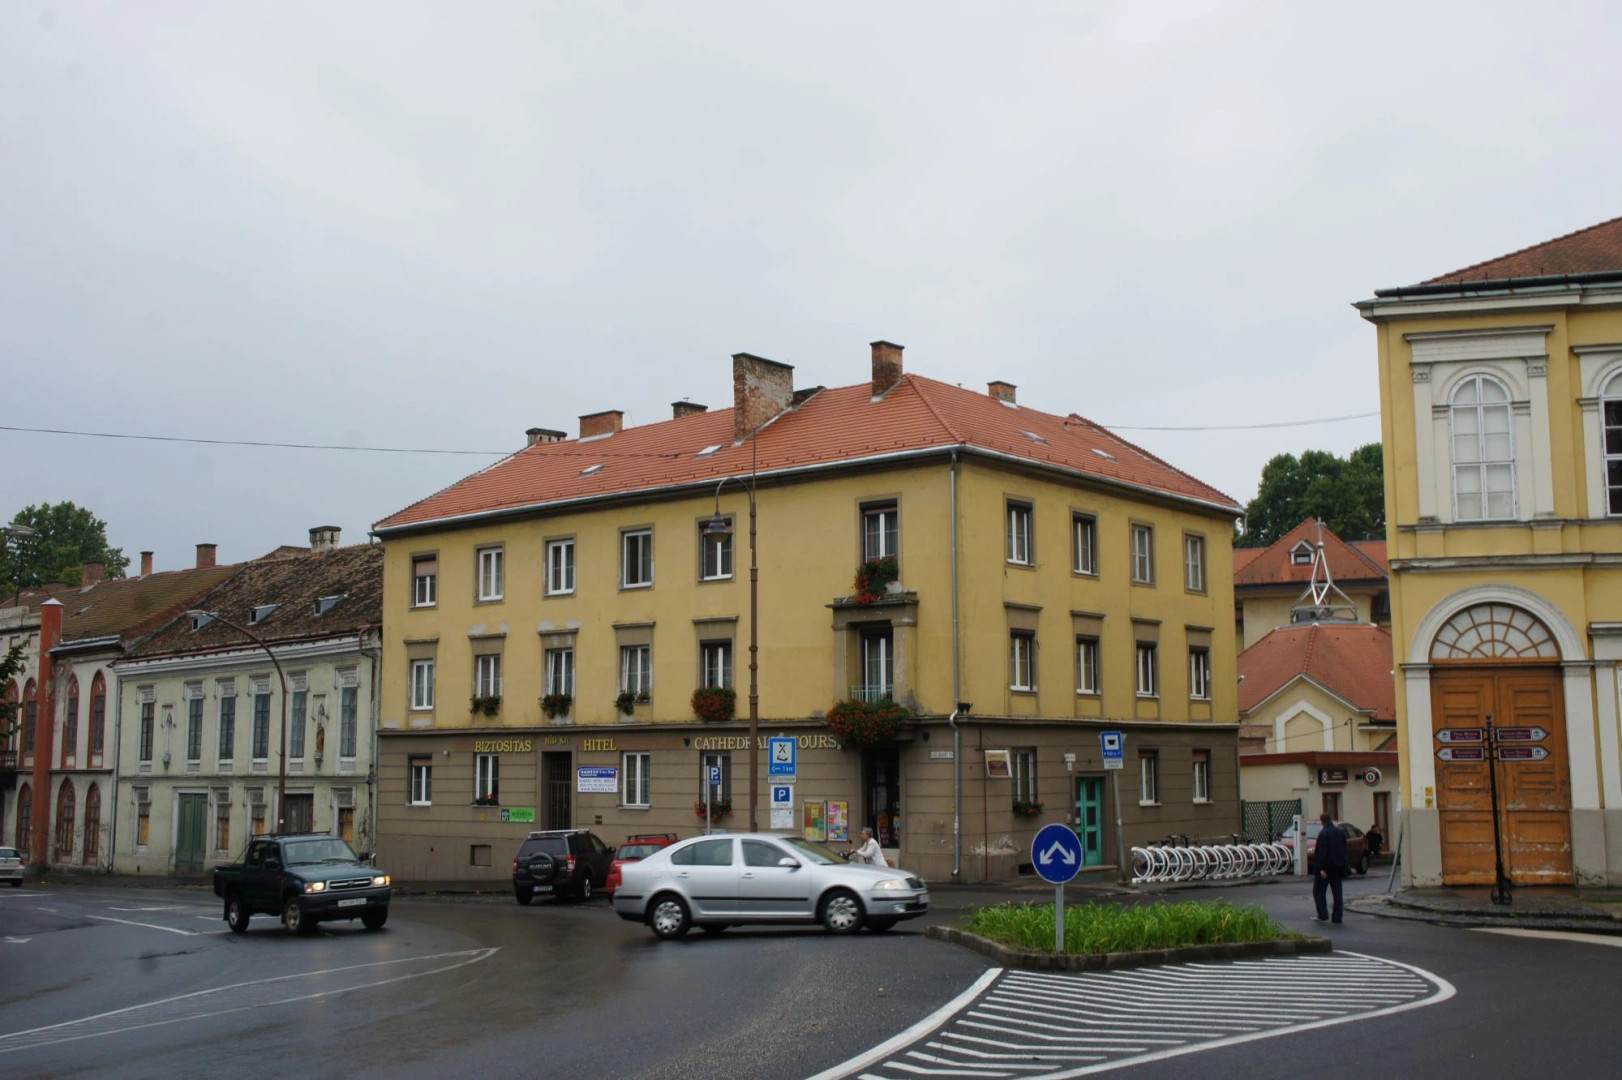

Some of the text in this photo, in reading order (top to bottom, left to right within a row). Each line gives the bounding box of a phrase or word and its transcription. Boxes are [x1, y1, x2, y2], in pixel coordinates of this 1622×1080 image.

[475, 737, 532, 752] BIZTOSÍTÁS
[583, 738, 617, 751] HITEL
[710, 767, 719, 780] P
[778, 789, 786, 800] P
